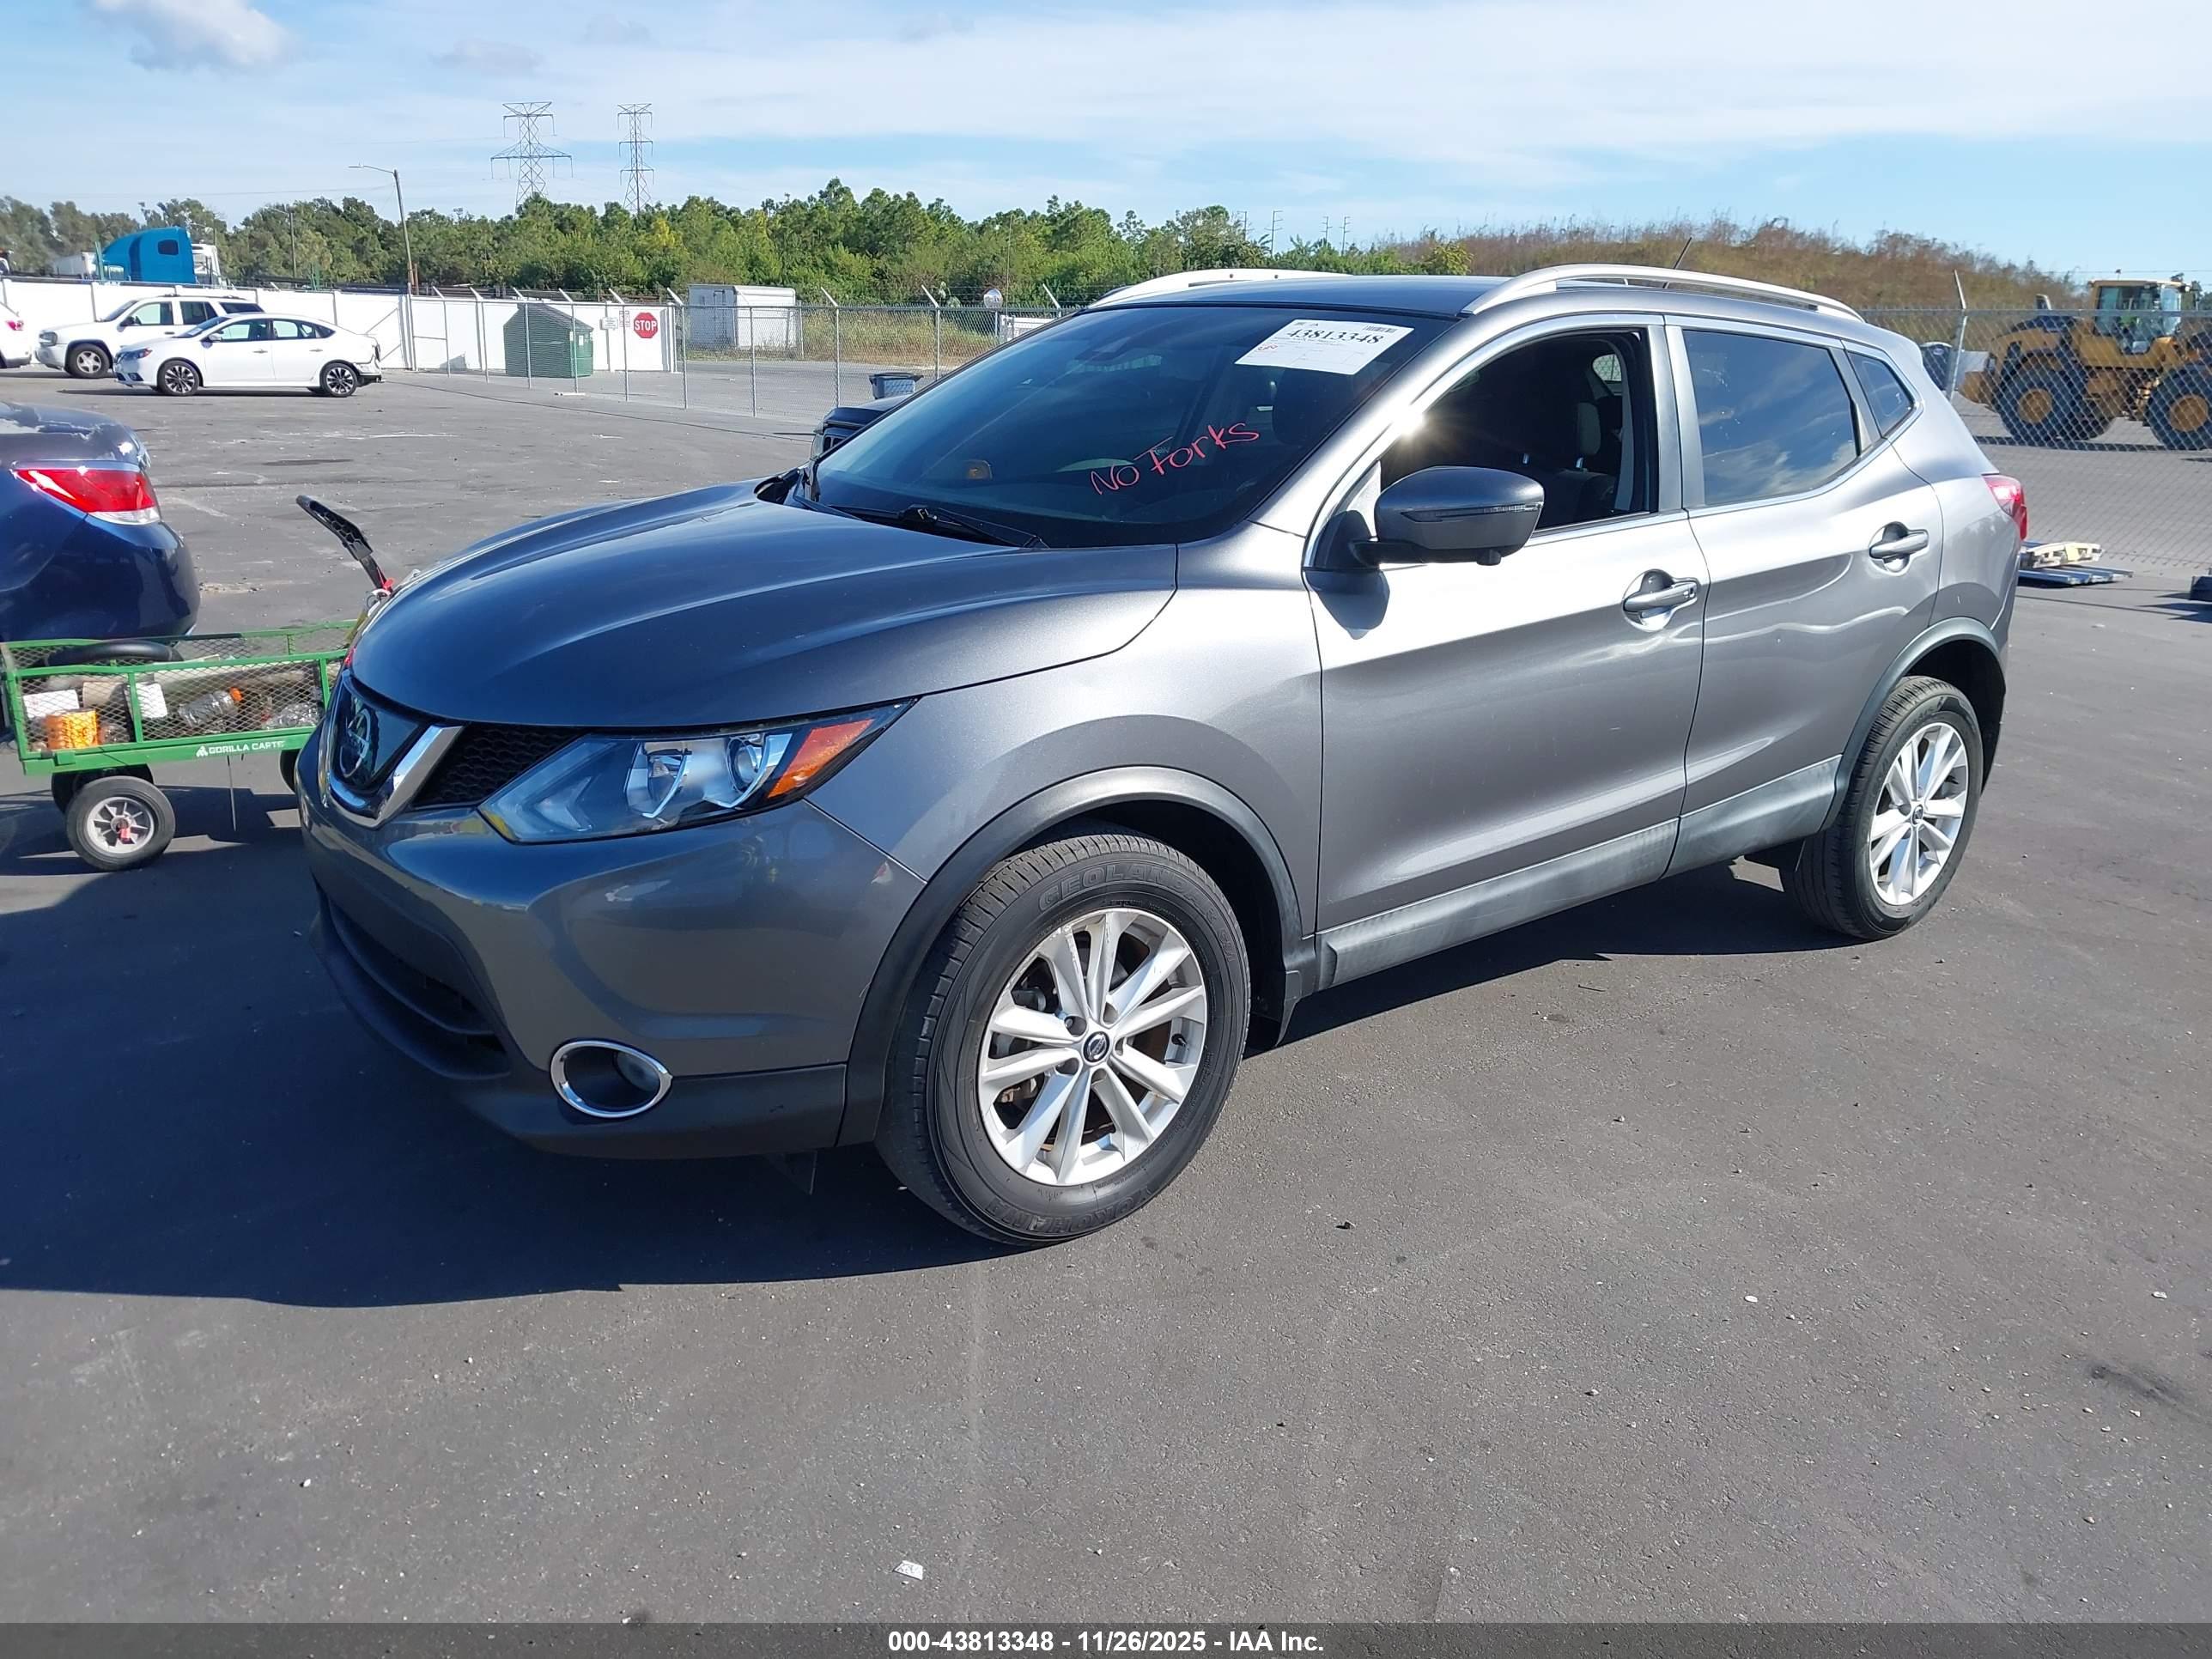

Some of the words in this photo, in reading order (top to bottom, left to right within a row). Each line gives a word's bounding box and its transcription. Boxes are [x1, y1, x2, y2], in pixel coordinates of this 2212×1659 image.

[635, 319, 657, 331] STOP
[1287, 328, 1384, 344] 43813348
[209, 744, 250, 755] GORILLA
